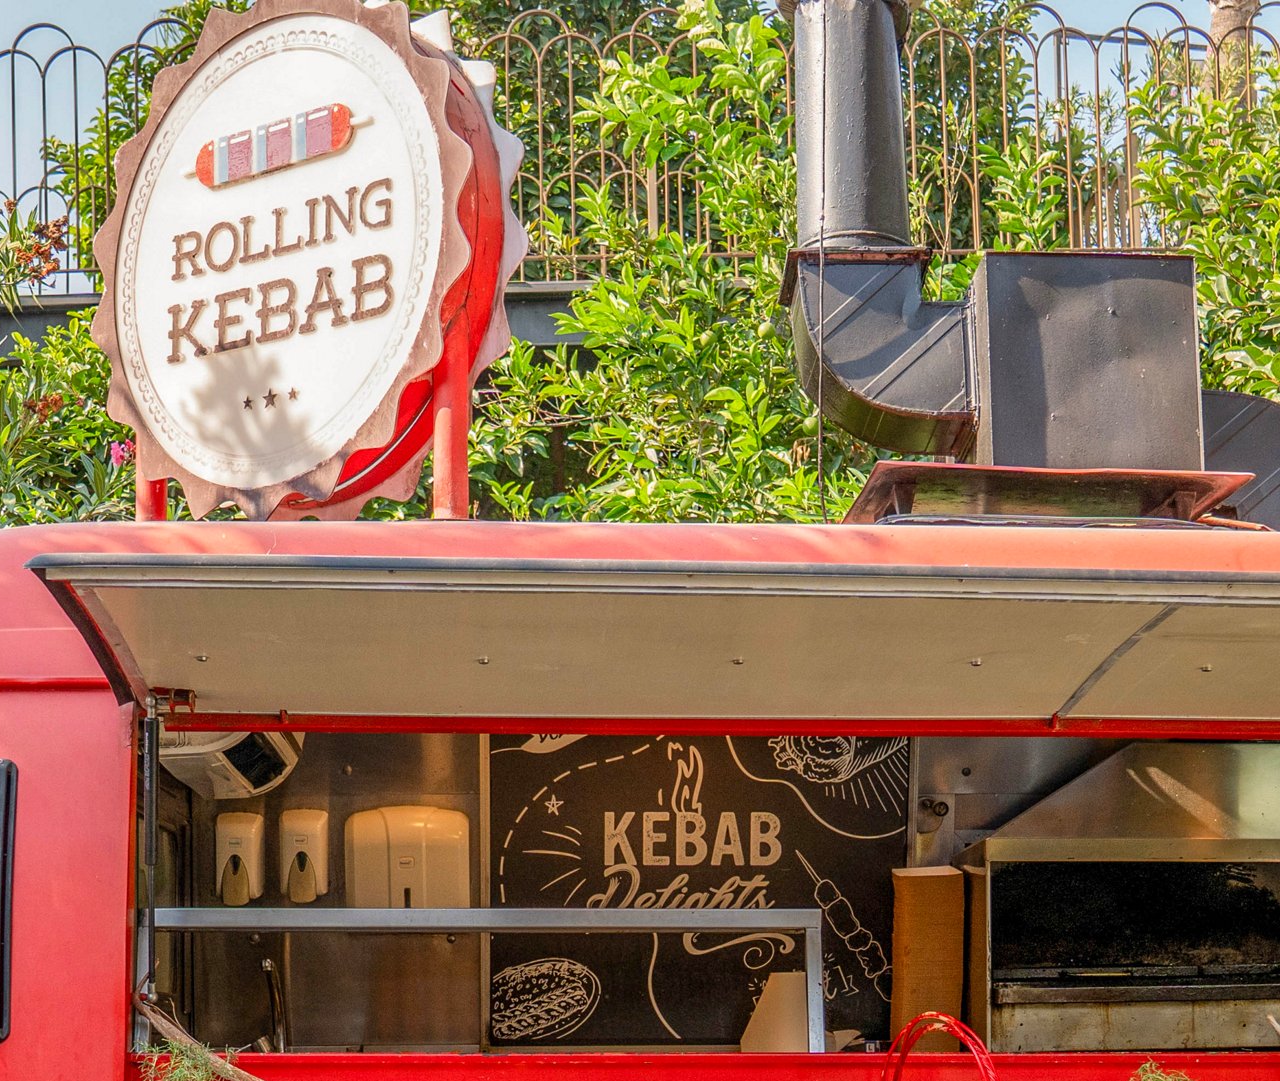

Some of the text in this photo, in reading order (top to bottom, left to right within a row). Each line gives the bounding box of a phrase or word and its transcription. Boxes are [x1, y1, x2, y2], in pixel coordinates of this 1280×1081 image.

[170, 177, 395, 282] ROLLING
[166, 253, 395, 365] KEBAB
[603, 811, 783, 867] KEBAB
